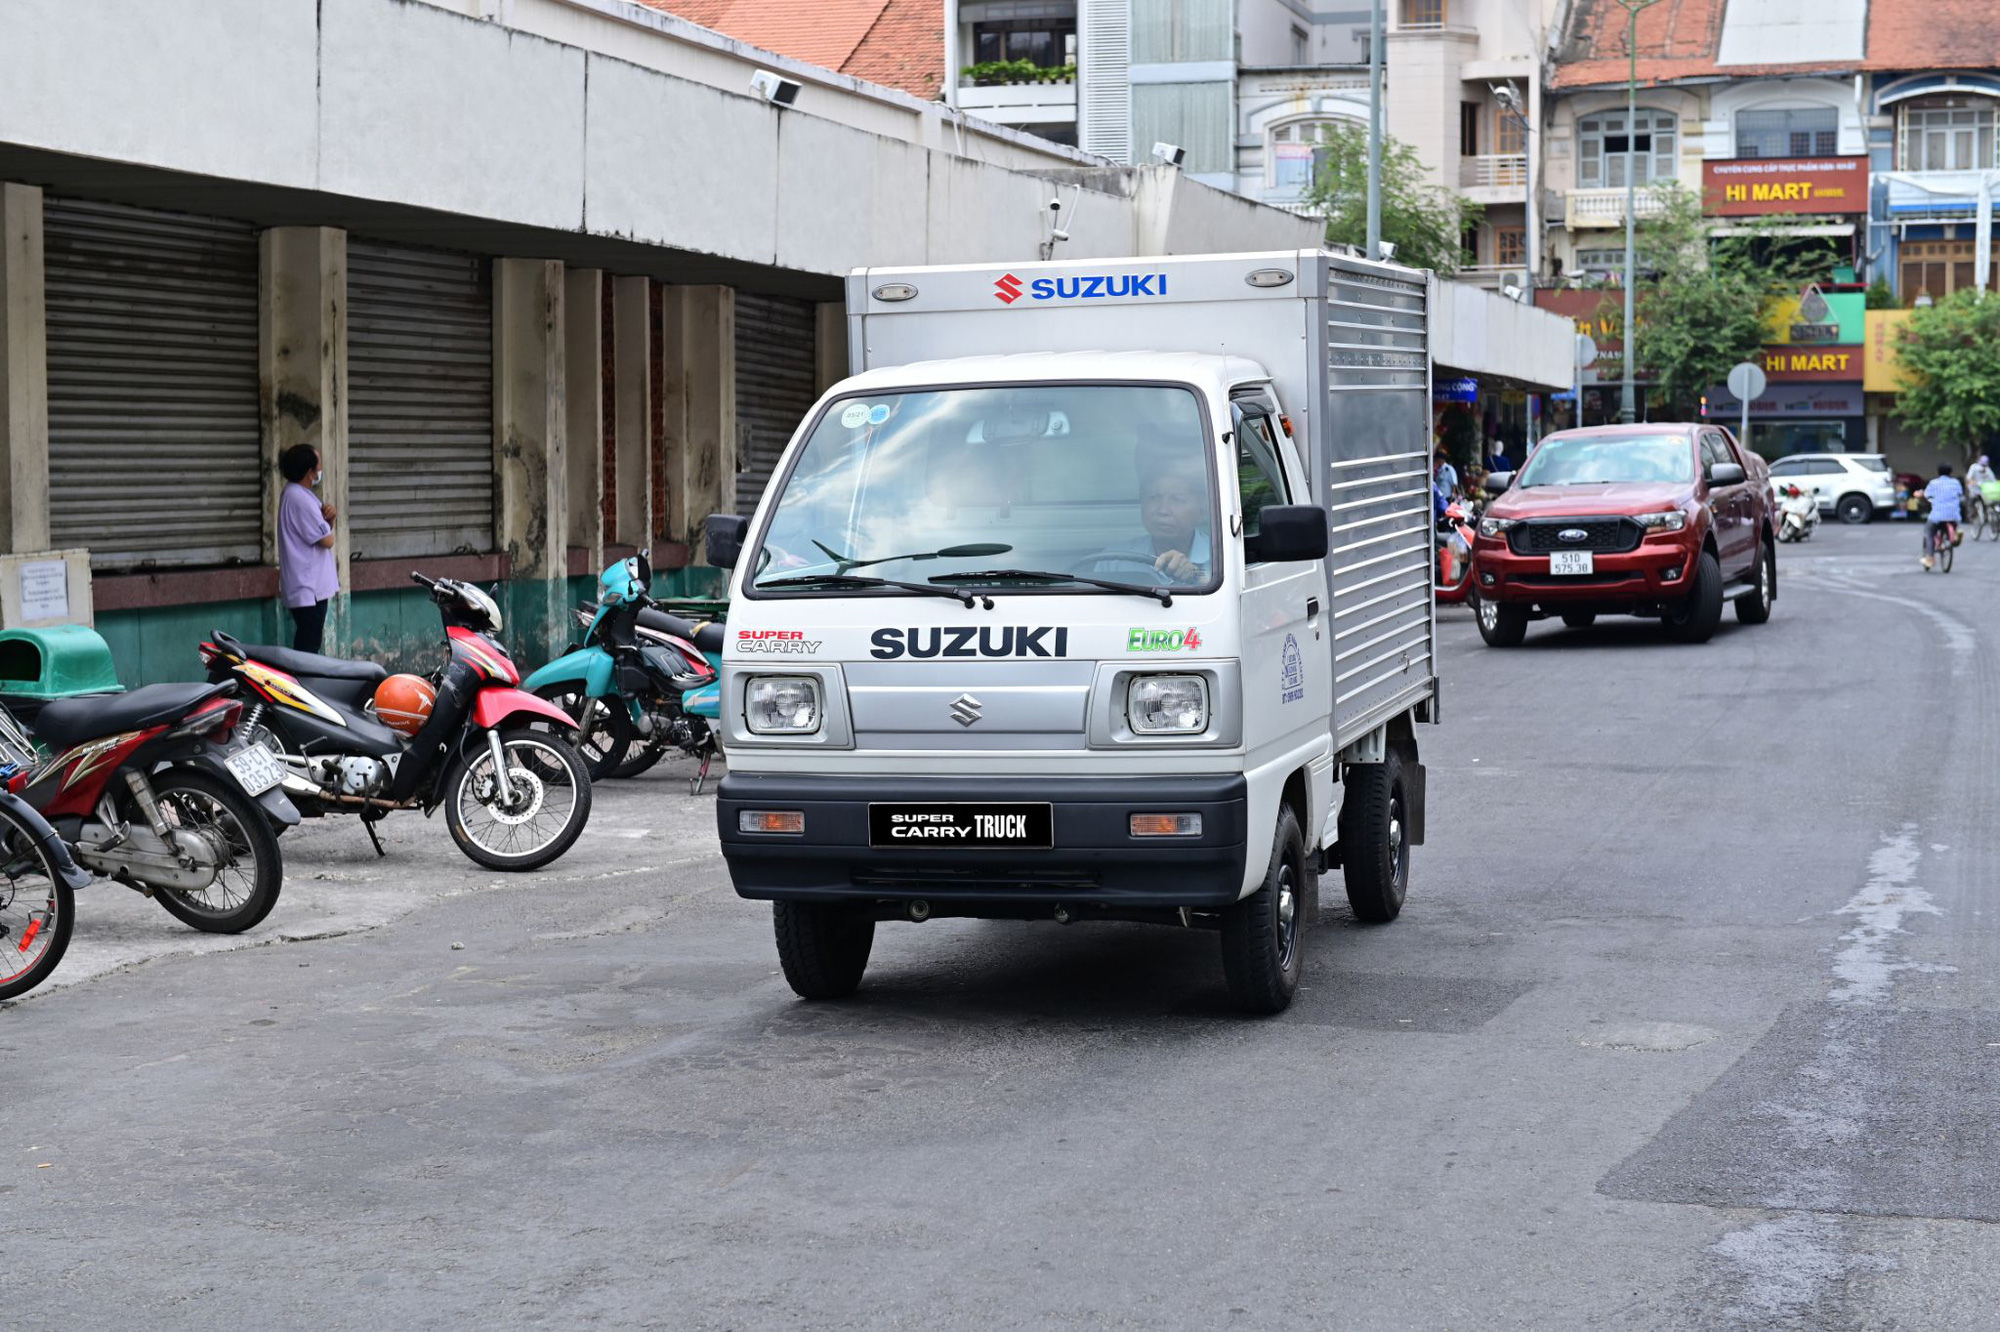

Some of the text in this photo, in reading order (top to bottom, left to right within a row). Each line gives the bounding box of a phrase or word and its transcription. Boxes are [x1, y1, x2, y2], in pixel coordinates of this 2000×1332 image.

[1726, 184, 1747, 201] HI
[1752, 182, 1813, 201] MART
[1031, 274, 1167, 300] SUZUKI
[1766, 354, 1849, 371] HI MART
[738, 630, 804, 640] SUPER
[870, 626, 1068, 659] SUZUKI
[736, 640, 822, 654] CARRY
[891, 814, 954, 823] SUPER
[891, 814, 1027, 838] CARRY TRUCK
